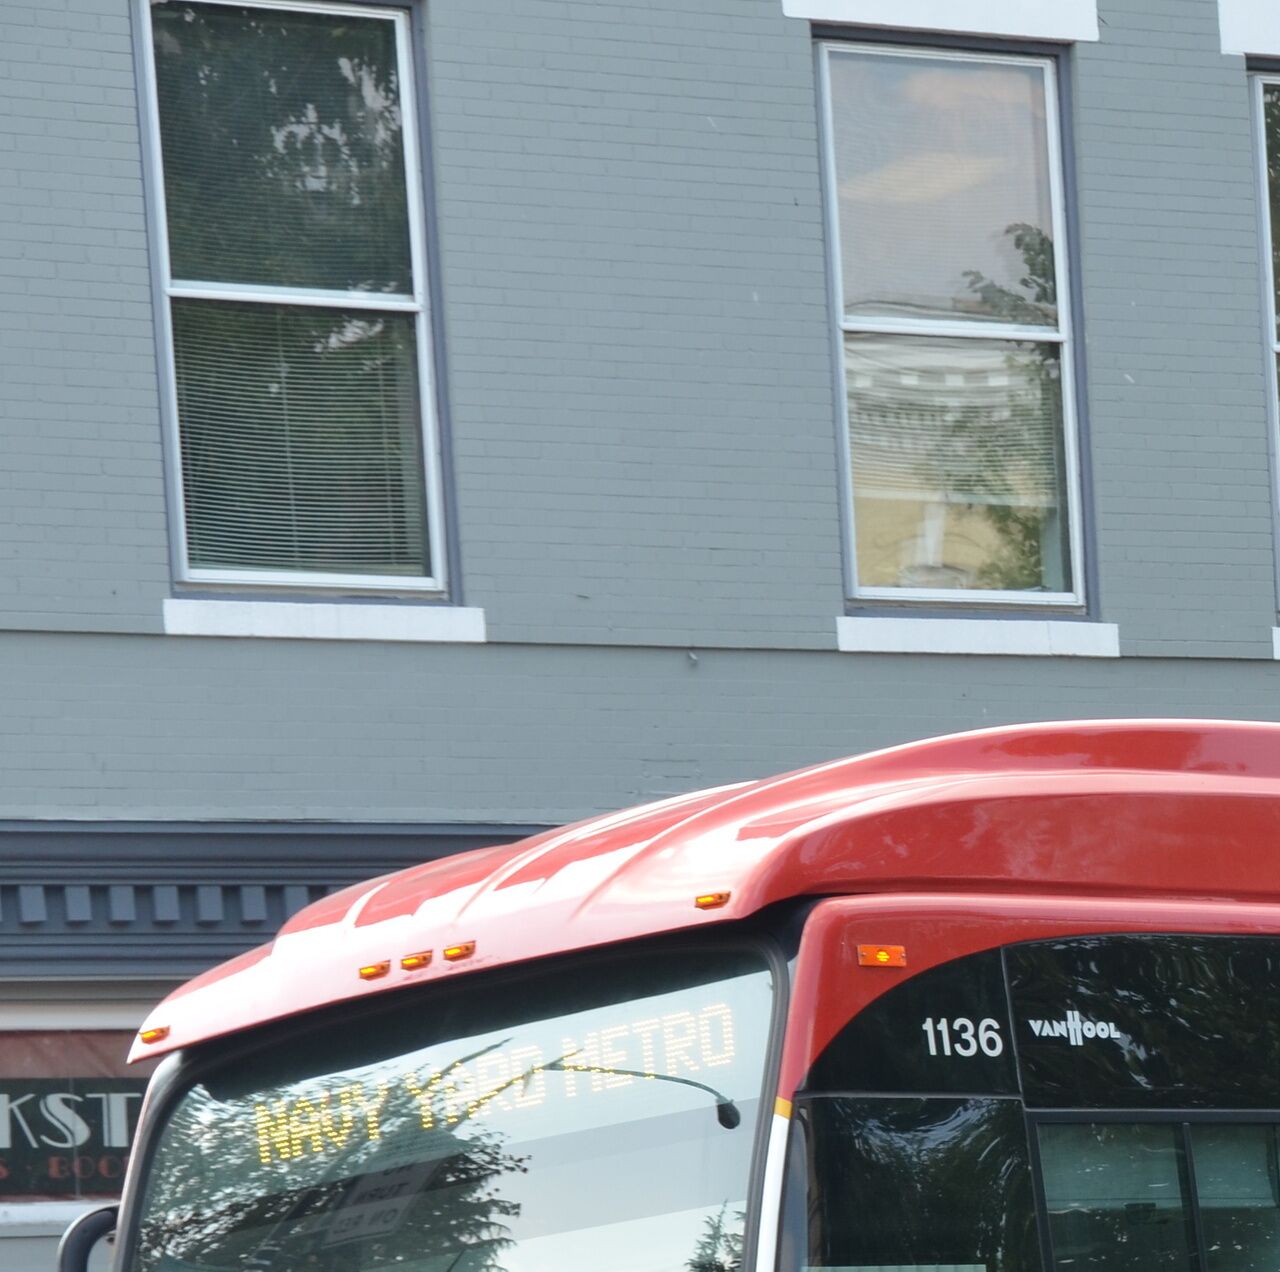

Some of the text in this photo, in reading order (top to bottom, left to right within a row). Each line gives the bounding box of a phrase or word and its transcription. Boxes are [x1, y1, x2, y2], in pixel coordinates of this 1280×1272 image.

[922, 1017, 1004, 1057] 1136
[255, 1003, 736, 1163] NAVY YARD METRO
[48, 1156, 130, 1179] BOO
